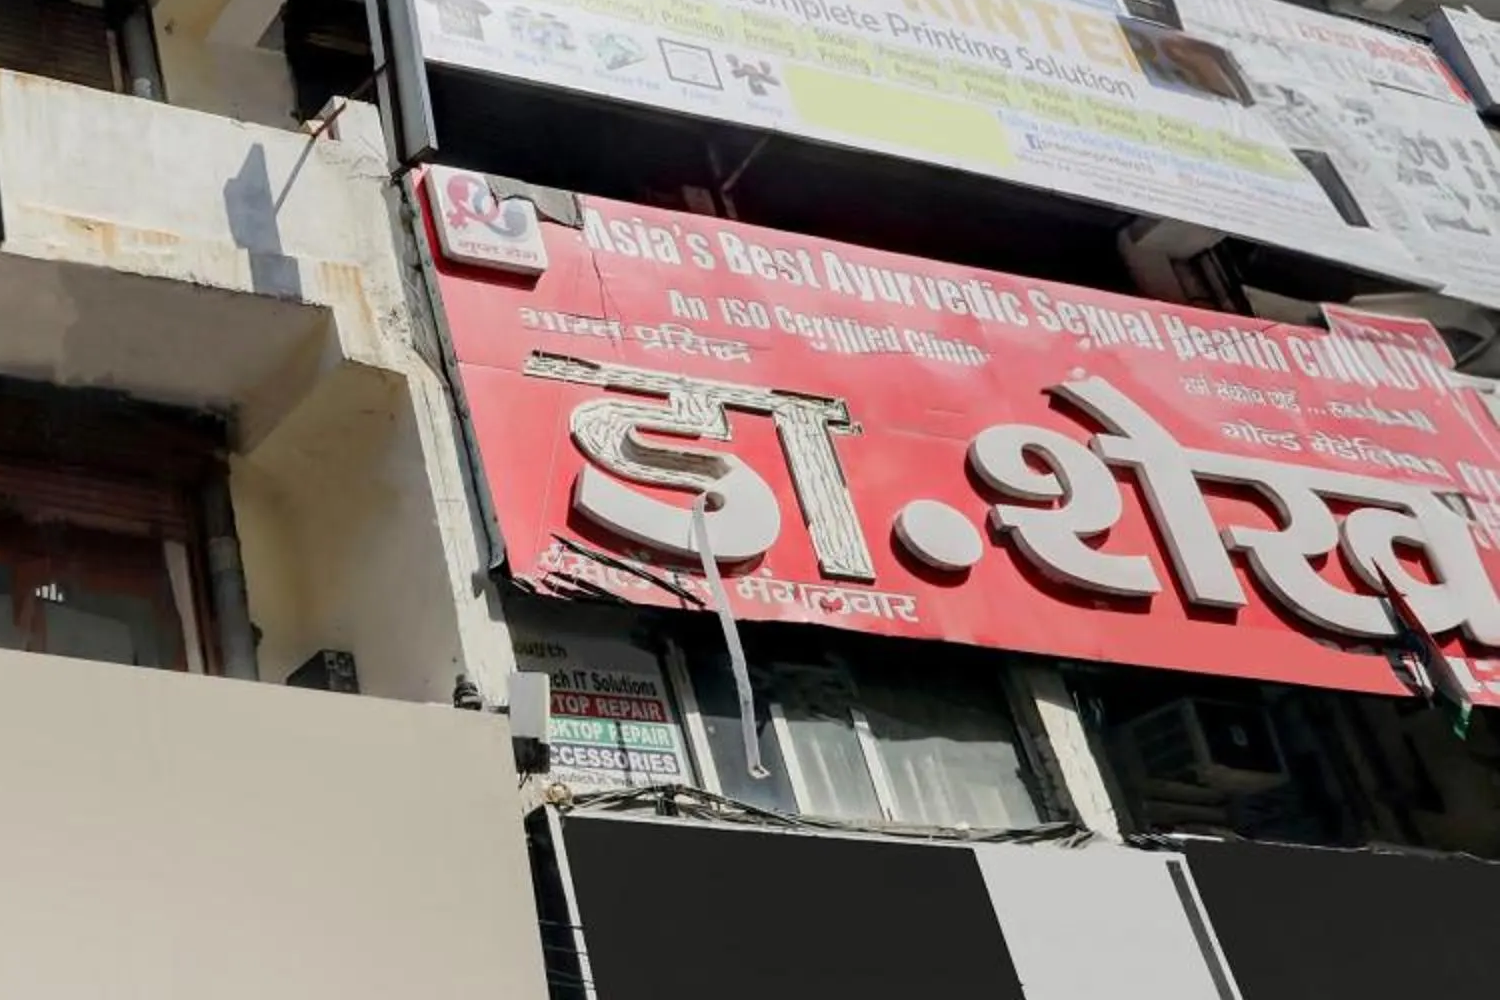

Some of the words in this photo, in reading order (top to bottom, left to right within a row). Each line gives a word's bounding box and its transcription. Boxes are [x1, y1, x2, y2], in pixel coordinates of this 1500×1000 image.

[886, 10, 1013, 69] Printing
[1015, 45, 1136, 100] Solution
[581, 207, 715, 271] Asia's
[717, 229, 821, 290] Best
[820, 249, 1029, 328] Ayurvedic
[1160, 312, 1291, 373] Health
[668, 289, 709, 321] An
[718, 297, 772, 331] ISO
[573, 671, 588, 690] IT
[592, 671, 658, 697] Solutions
[551, 693, 593, 714] TOP
[595, 697, 663, 721] REPAIR
